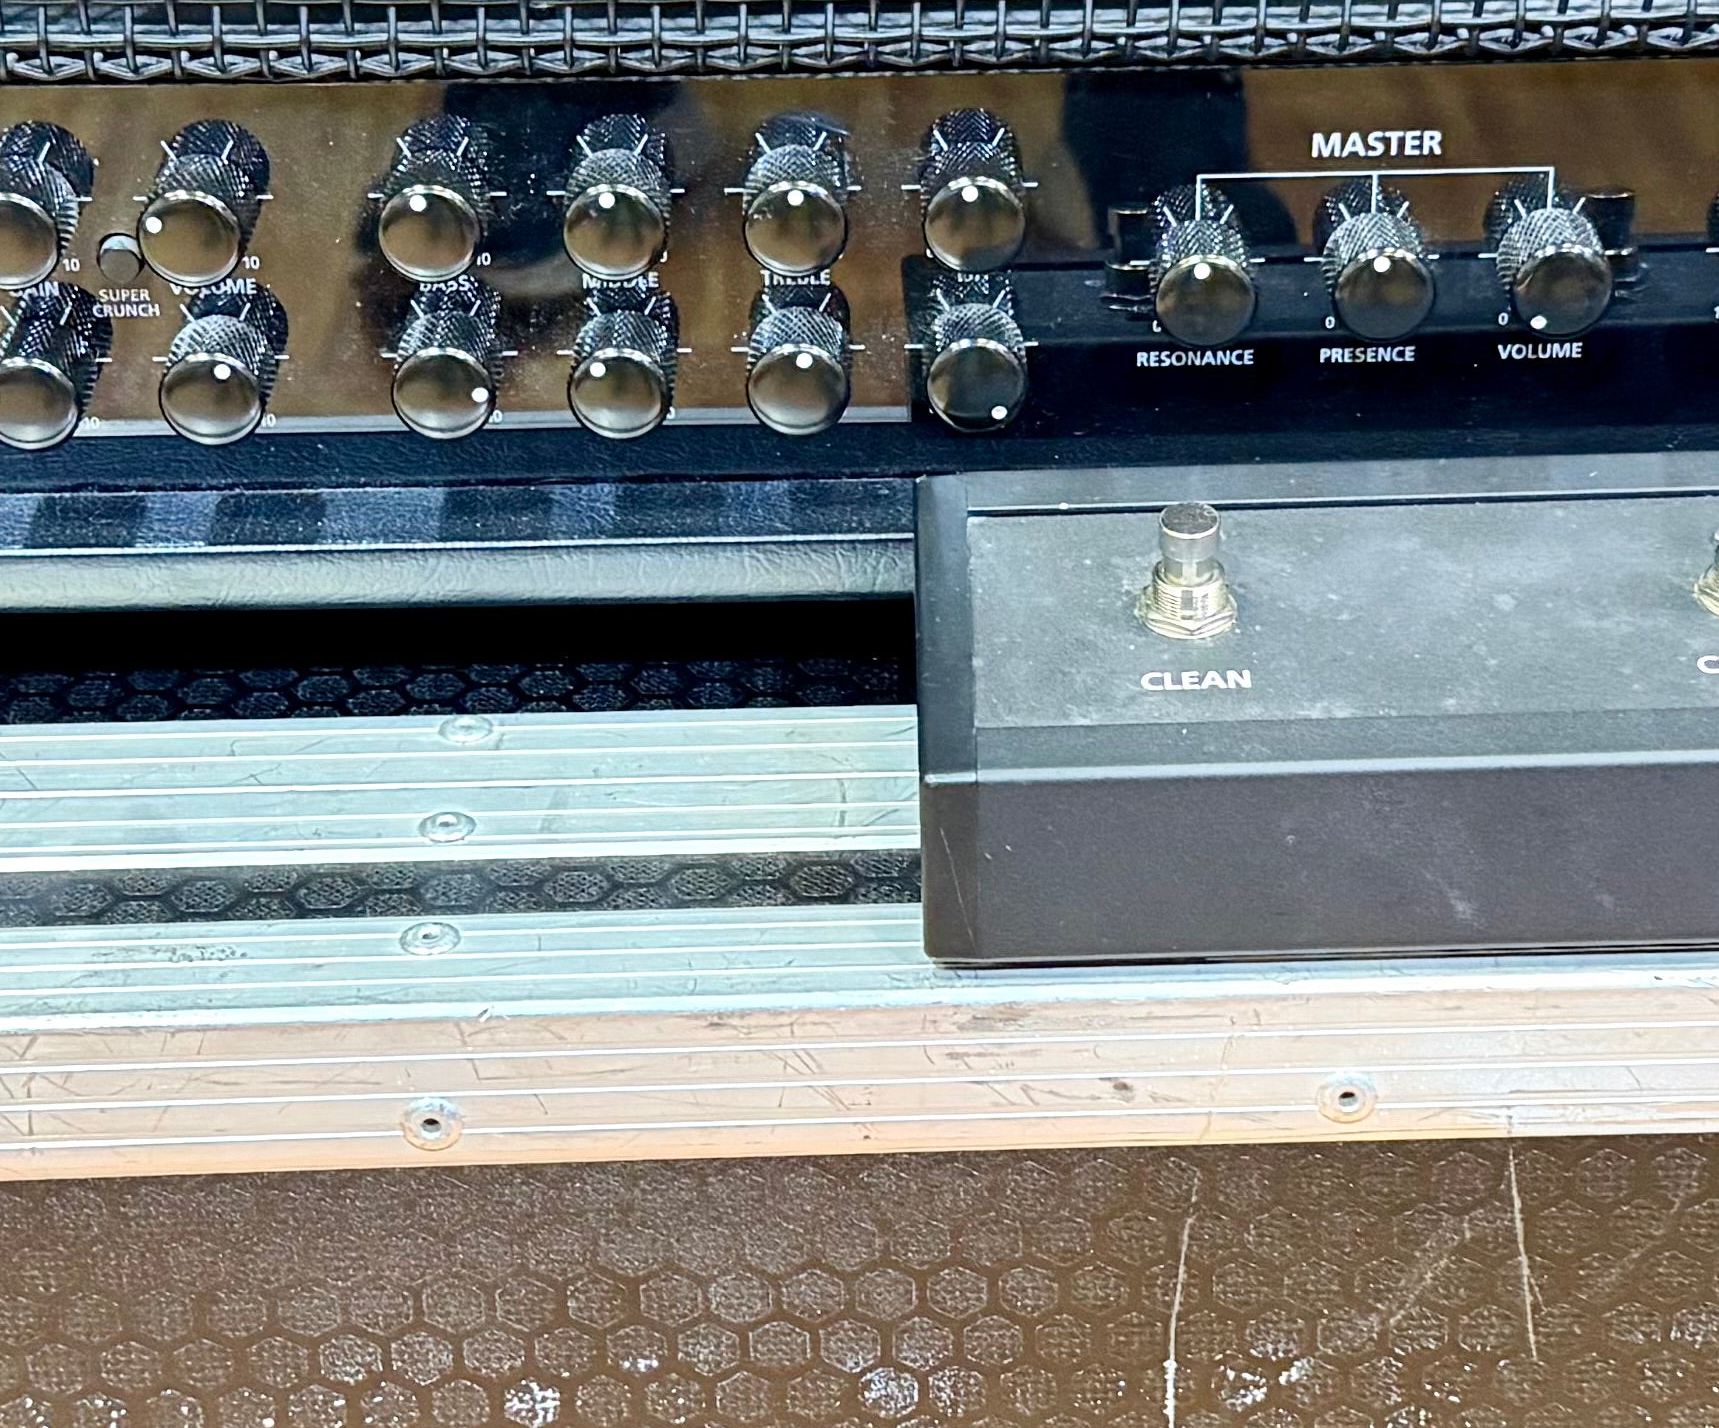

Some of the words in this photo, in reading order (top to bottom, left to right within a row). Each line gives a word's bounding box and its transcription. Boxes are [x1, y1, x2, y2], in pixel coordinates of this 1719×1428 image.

[1311, 130, 1443, 158] MASTER
[62, 259, 81, 272] 10
[242, 255, 260, 270] 10
[98, 288, 151, 303] SUPER
[92, 303, 161, 318] CRUNCH
[1136, 349, 1255, 368] RESONANCE
[1319, 345, 1417, 364] PRESENCE
[1497, 341, 1584, 360] VOLUME
[1140, 669, 1252, 691] CLEAN
